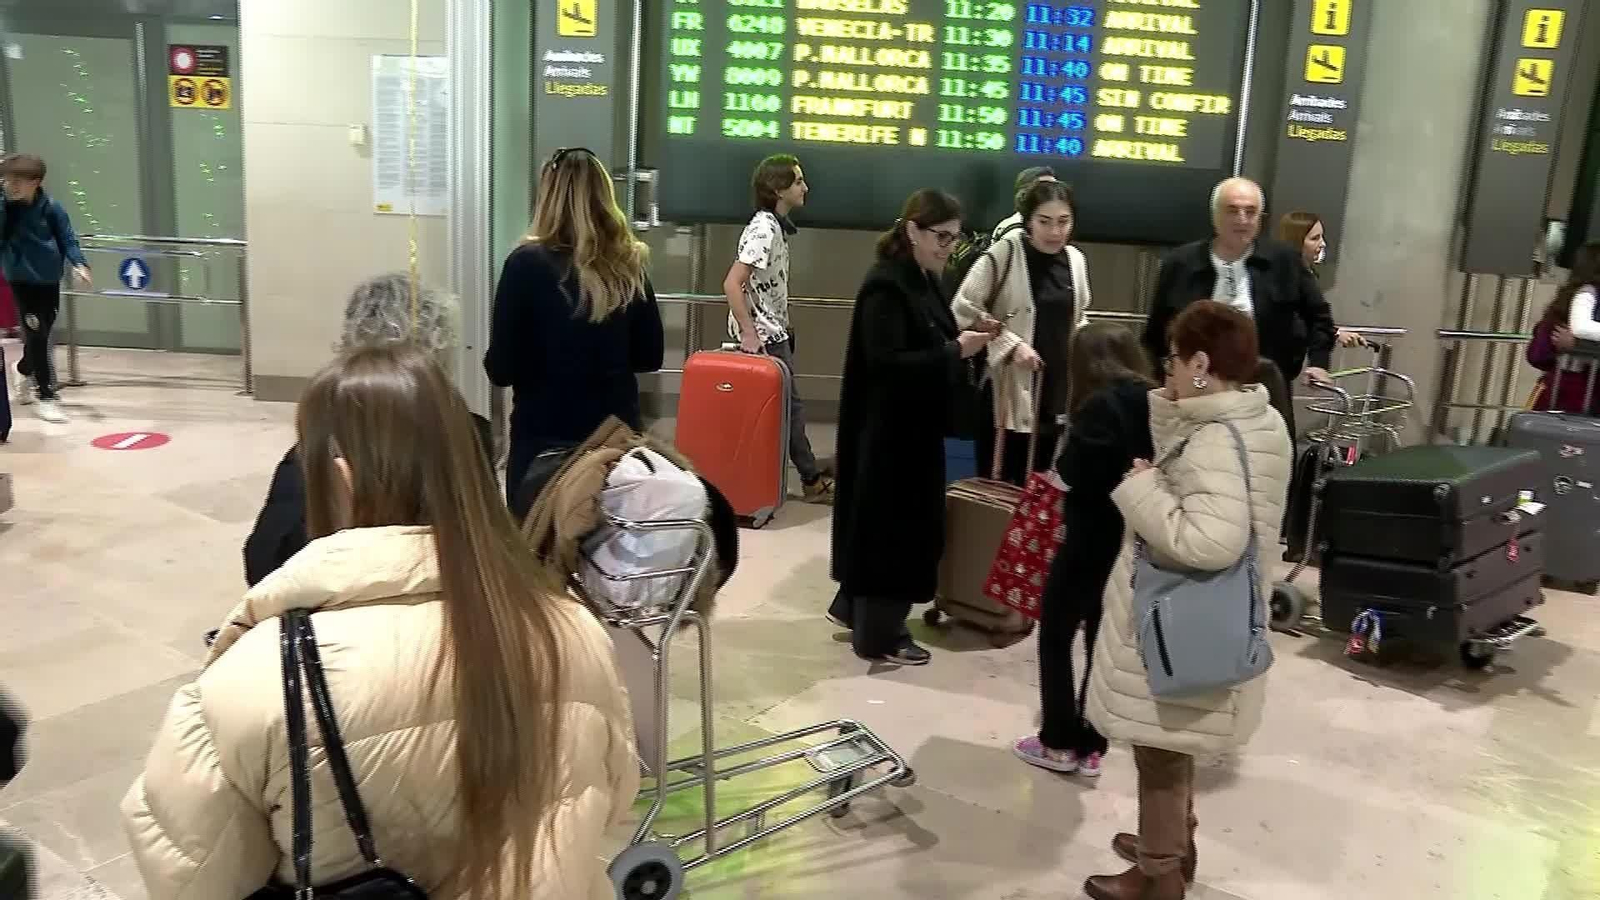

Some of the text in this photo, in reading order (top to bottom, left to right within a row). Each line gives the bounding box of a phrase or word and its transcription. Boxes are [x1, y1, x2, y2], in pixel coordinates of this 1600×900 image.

[672, 12, 704, 30] FR
[796, 17, 935, 42] VENECIA-TR
[943, 26, 1014, 47] 11:30
[1024, 30, 1092, 53] 11:14
[1101, 37, 1196, 60] ARRIVAL
[1026, 4, 1094, 27] 11:32
[1103, 11, 1198, 34] ARRIVAL
[670, 38, 702, 56] UX
[793, 43, 933, 68] P.MALLORCA
[941, 52, 1012, 73] 11:35
[1021, 56, 1091, 79] 11:40
[1098, 62, 1130, 81] ON
[1138, 65, 1194, 86] TIME
[545, 81, 608, 98] Llegadas
[792, 69, 931, 94] P.MALLORCA
[940, 78, 1010, 99] 11:45
[1020, 82, 1088, 104] 11:45
[1096, 88, 1141, 108] SIN
[1149, 92, 1231, 114] CONFIR
[669, 90, 700, 108] LH
[791, 95, 914, 119] FRANKFURT
[937, 104, 1008, 124] 11:50
[1018, 108, 1086, 130] 11:45
[1094, 114, 1125, 133] ON
[1133, 116, 1189, 136] TIME
[1287, 109, 1333, 124] Arrivals
[1287, 124, 1347, 142] Llegadas
[791, 122, 900, 144] TENERIFE
[935, 129, 1006, 150] 11:50
[1015, 133, 1083, 156] 11:40
[1092, 139, 1185, 162] ARRIVAL
